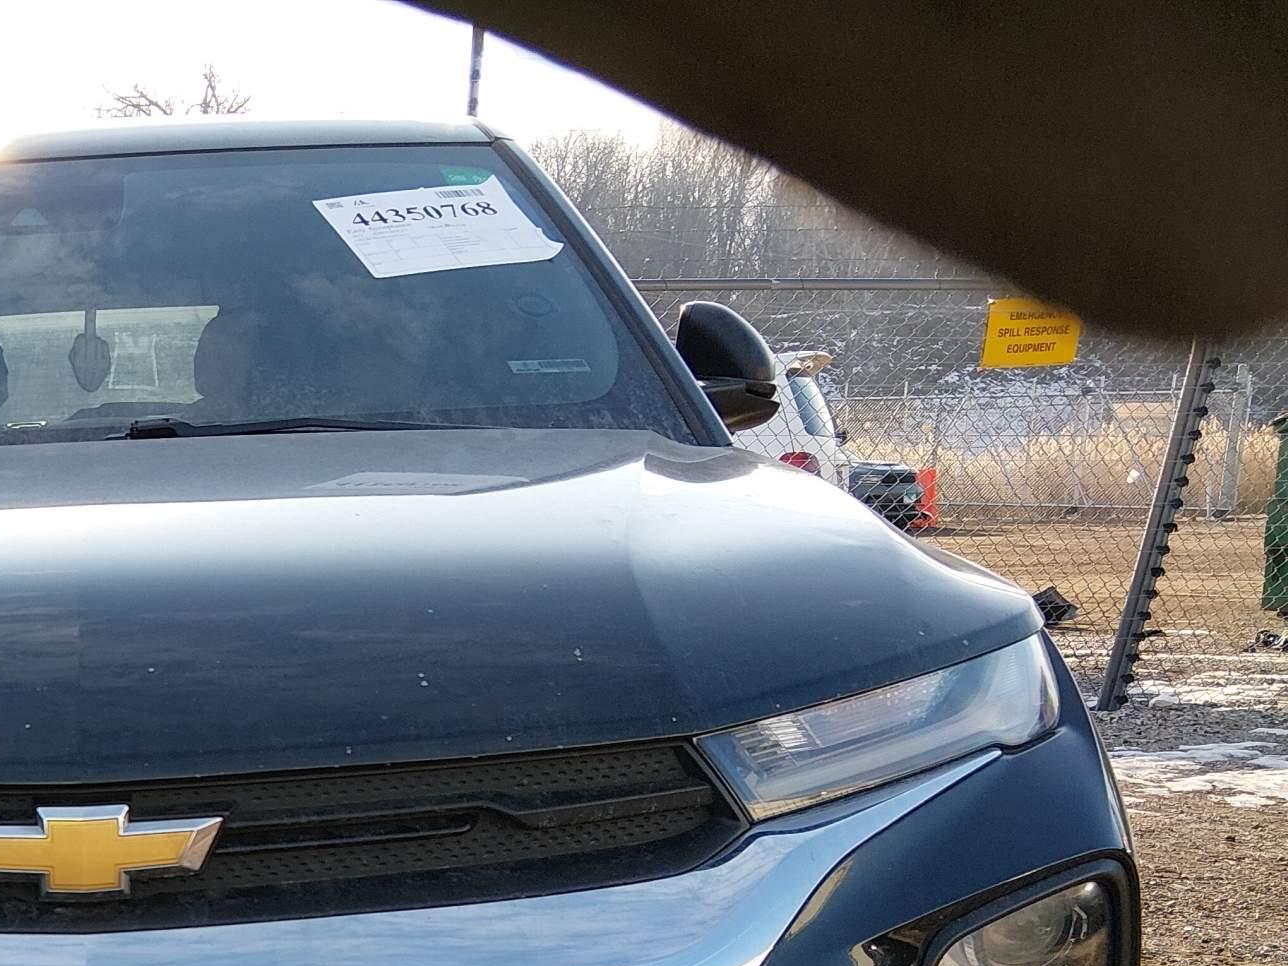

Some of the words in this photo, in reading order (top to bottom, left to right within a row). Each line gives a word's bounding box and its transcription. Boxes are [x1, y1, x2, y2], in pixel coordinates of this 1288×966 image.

[352, 200, 498, 226] 44350768
[998, 327, 1022, 338] SPILL
[1024, 325, 1071, 337] RESPONSE
[1006, 342, 1057, 354] EQUIPMENT
